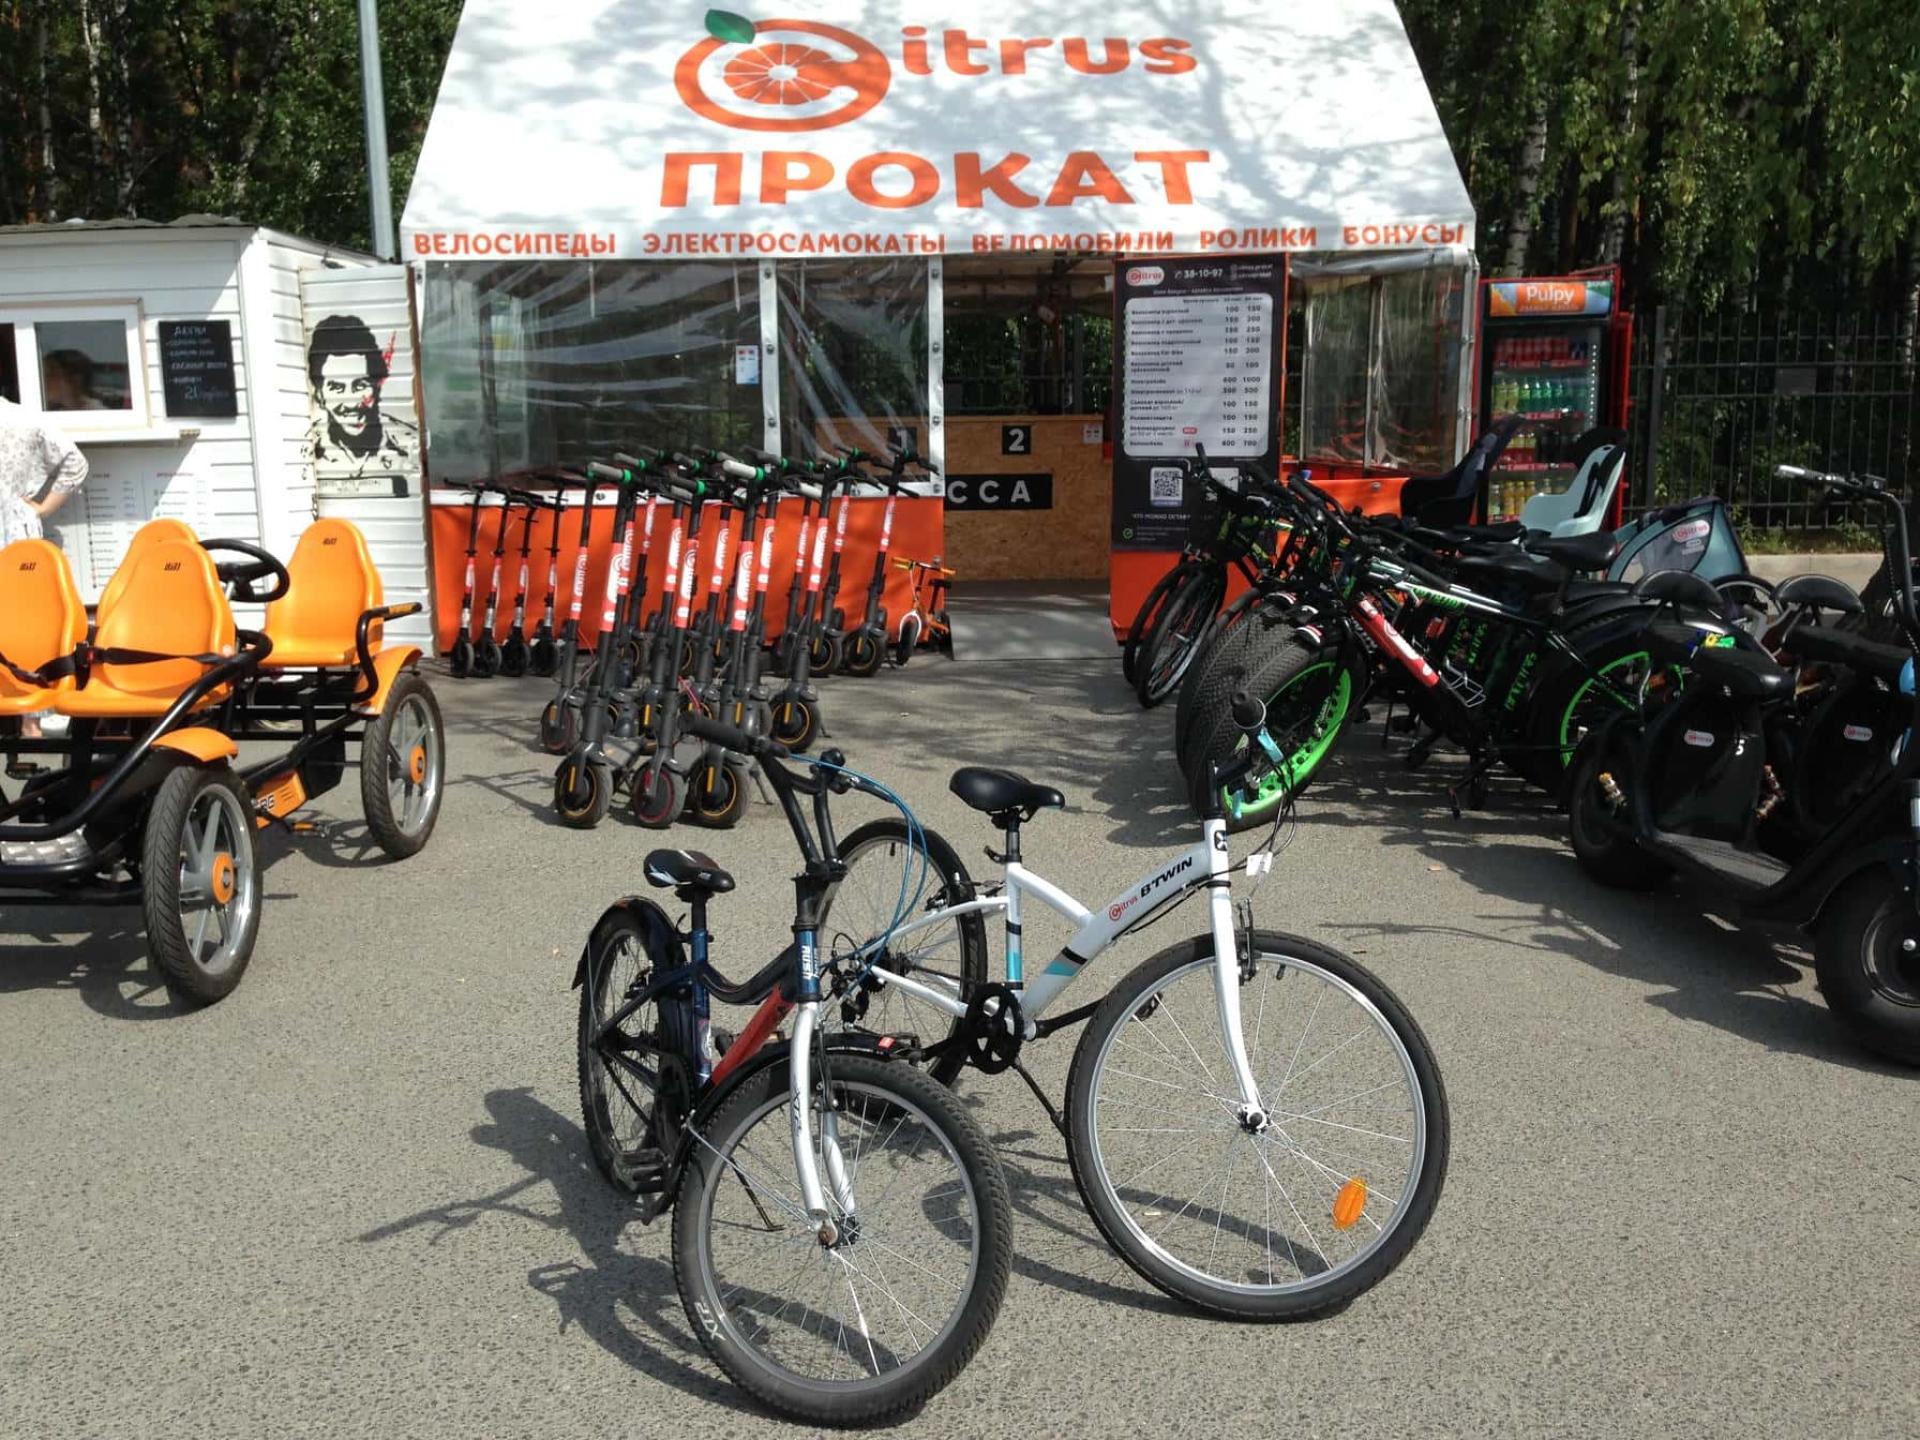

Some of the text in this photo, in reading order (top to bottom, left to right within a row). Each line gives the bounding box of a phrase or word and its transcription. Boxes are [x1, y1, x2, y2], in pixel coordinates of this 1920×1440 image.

[660, 151, 1209, 209] ПРОКАТ
[414, 223, 1465, 257] ВЕЛОСИПЕДЫ ЭЛЕКТРОСАМОКАТЫ ВЕЛОМОБИЛИ РОЛИКИ БОНУСЫ
[1526, 285, 1575, 305] Pulpy
[1008, 429, 1025, 452] 2
[947, 480, 1031, 504] ССА
